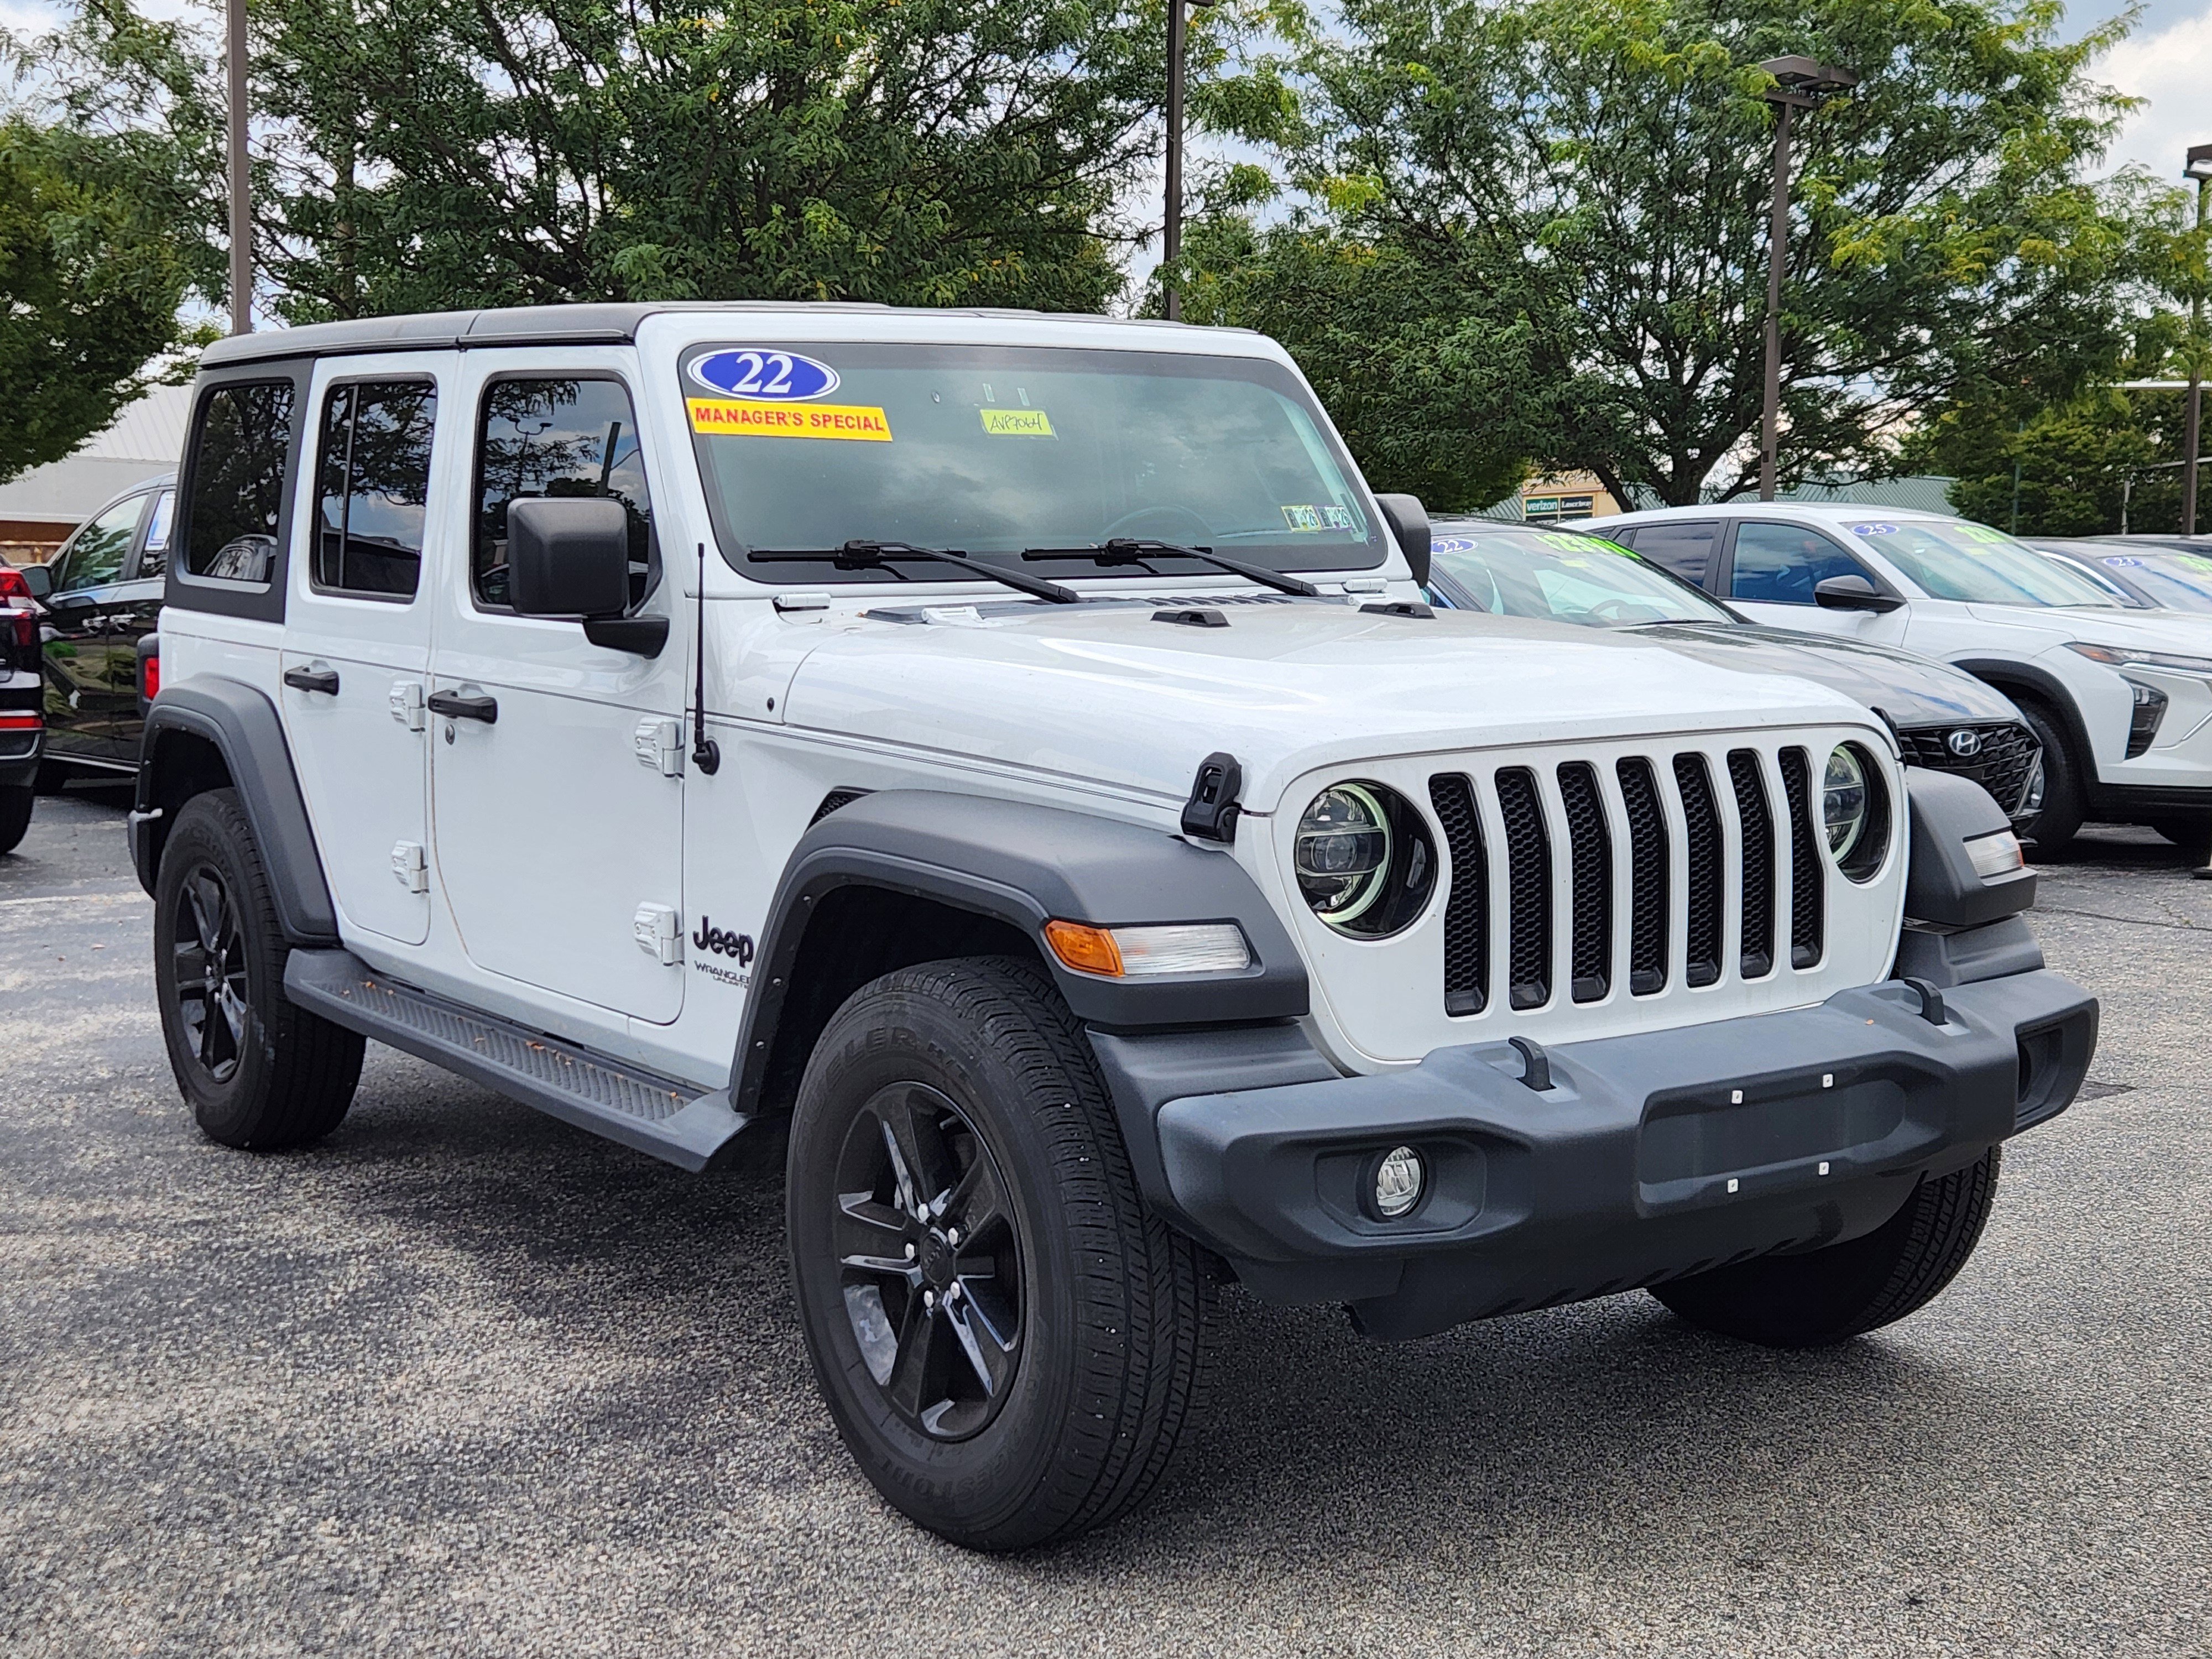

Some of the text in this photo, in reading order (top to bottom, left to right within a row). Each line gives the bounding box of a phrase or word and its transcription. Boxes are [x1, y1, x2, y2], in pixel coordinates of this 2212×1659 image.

[732, 353, 793, 393] 22
[696, 407, 885, 432] MANAGER'S SPECIAL
[1527, 500, 1558, 512] verizon
[1863, 523, 1887, 535] 25
[1437, 540, 1464, 553] 22
[692, 915, 754, 968] Jeep
